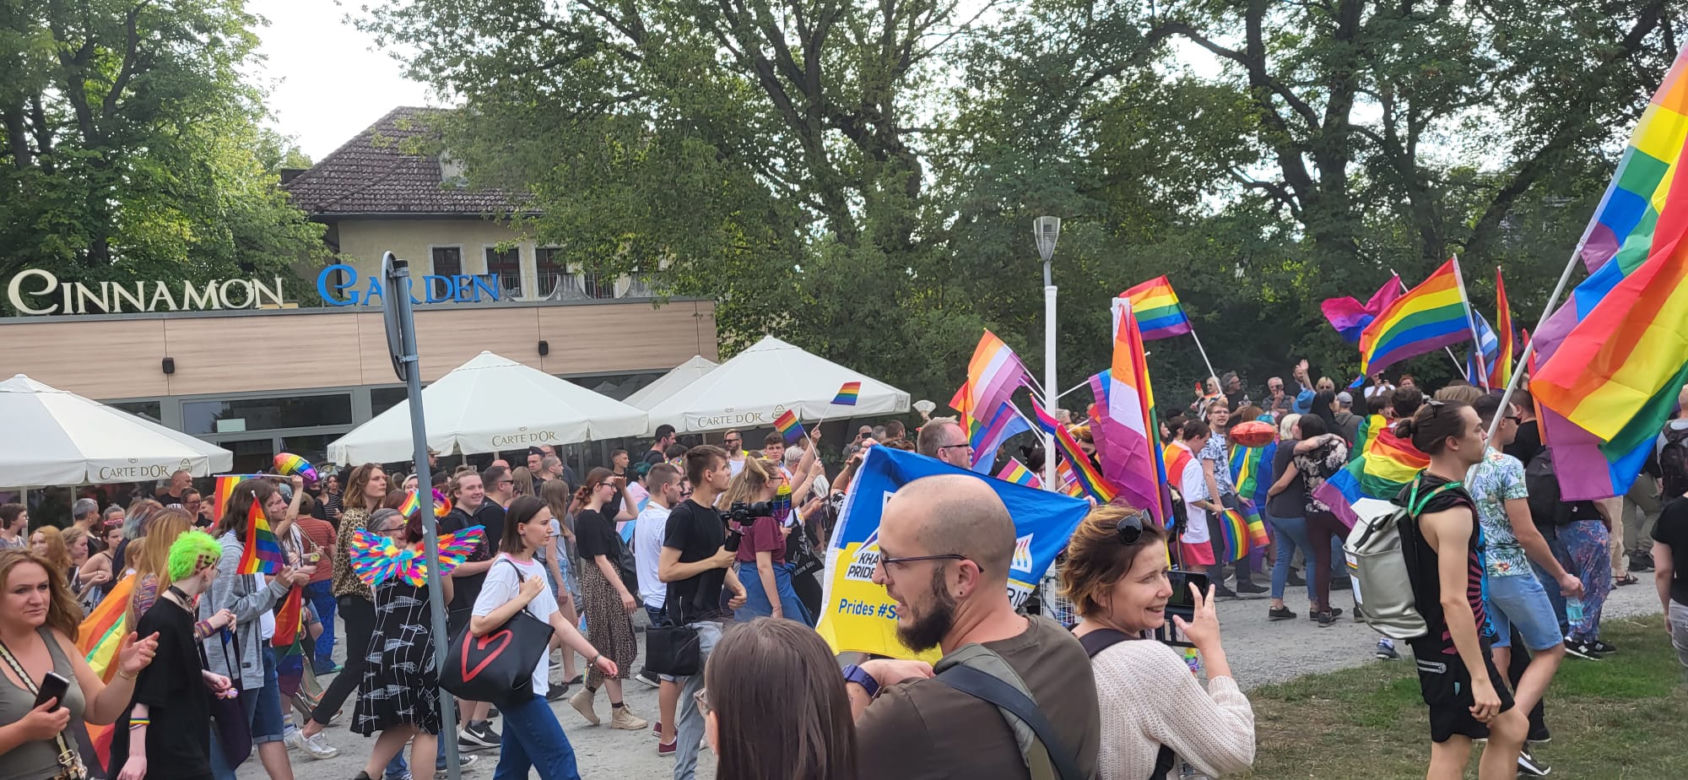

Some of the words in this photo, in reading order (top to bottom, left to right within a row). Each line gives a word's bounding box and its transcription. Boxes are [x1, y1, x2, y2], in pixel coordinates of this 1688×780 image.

[8, 268, 284, 315] CINNAMON
[697, 415, 732, 428] CARTE
[491, 434, 526, 447] CARTE
[99, 466, 136, 480] CARTE
[140, 464, 171, 478] D'OR
[838, 598, 875, 616] Prides
